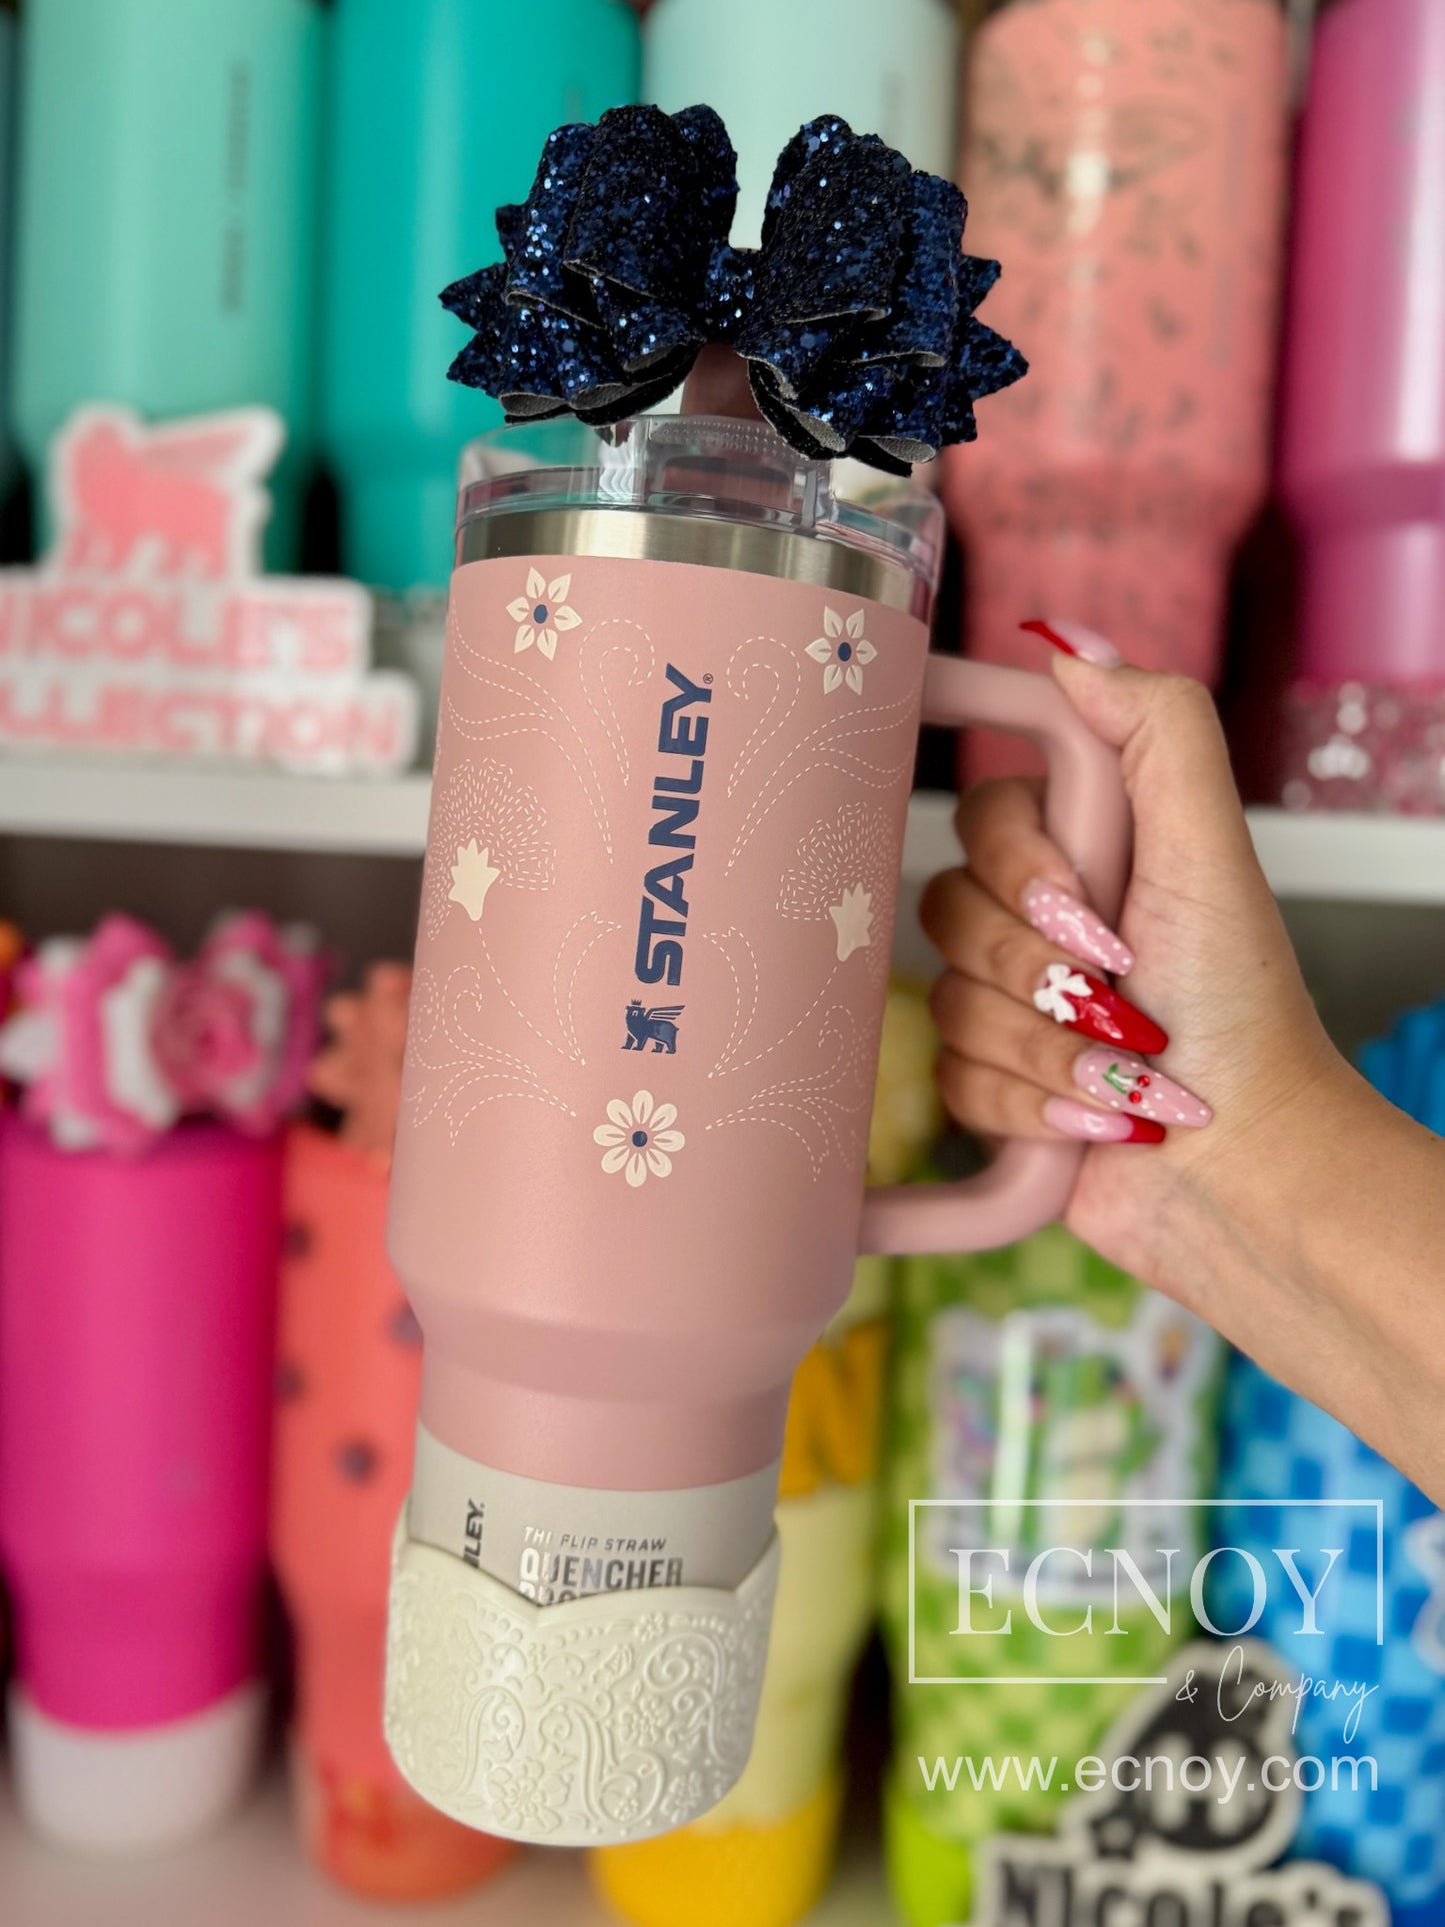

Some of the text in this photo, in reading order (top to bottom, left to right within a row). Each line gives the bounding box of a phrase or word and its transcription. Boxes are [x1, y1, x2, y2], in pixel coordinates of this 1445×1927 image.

[560, 1533, 598, 1550] FLIP
[604, 1537, 668, 1552] STRAW
[519, 1547, 683, 1589] QUENCHER
